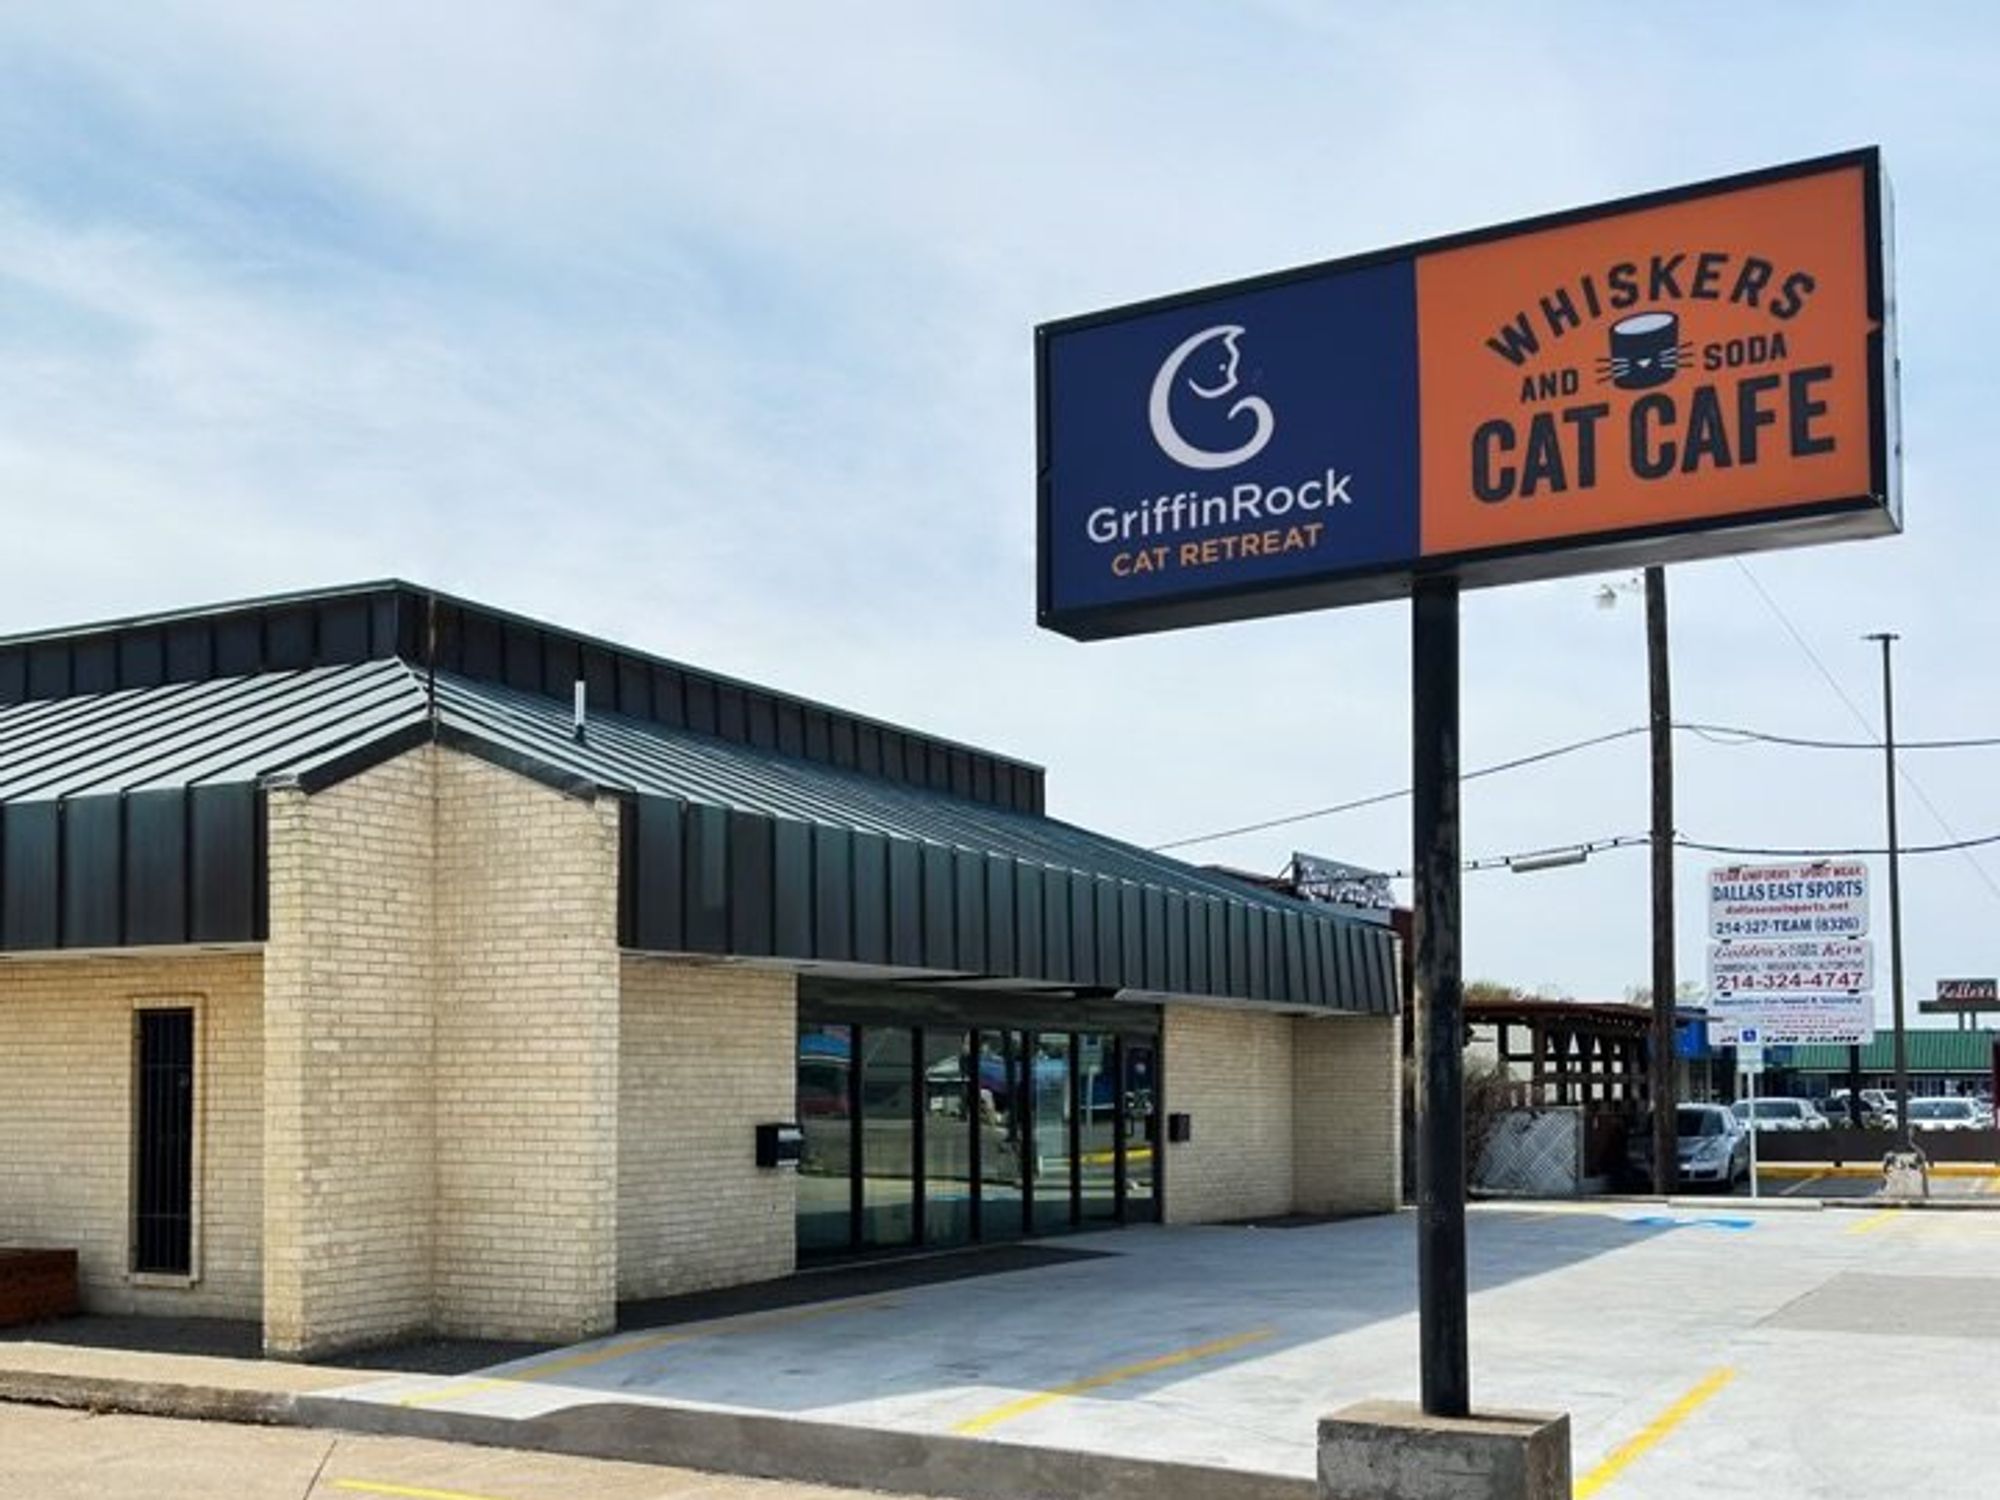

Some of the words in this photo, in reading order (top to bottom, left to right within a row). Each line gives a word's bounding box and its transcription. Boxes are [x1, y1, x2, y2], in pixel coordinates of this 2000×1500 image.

[1486, 252, 1816, 367] WHISKERS
[1703, 332, 1787, 371] SODA
[1520, 368, 1579, 403] AND
[1471, 404, 1609, 503] CAT
[1630, 365, 1835, 480] CAFE
[1086, 468, 1351, 543] GriffinRock
[1111, 546, 1169, 577] CAT
[1179, 522, 1324, 567] RETREAT
[1712, 883, 1766, 901] DALLAS
[1768, 881, 1804, 900] EAST
[1806, 880, 1863, 899] SPORTS
[1716, 972, 1864, 990] 214-324-4747
